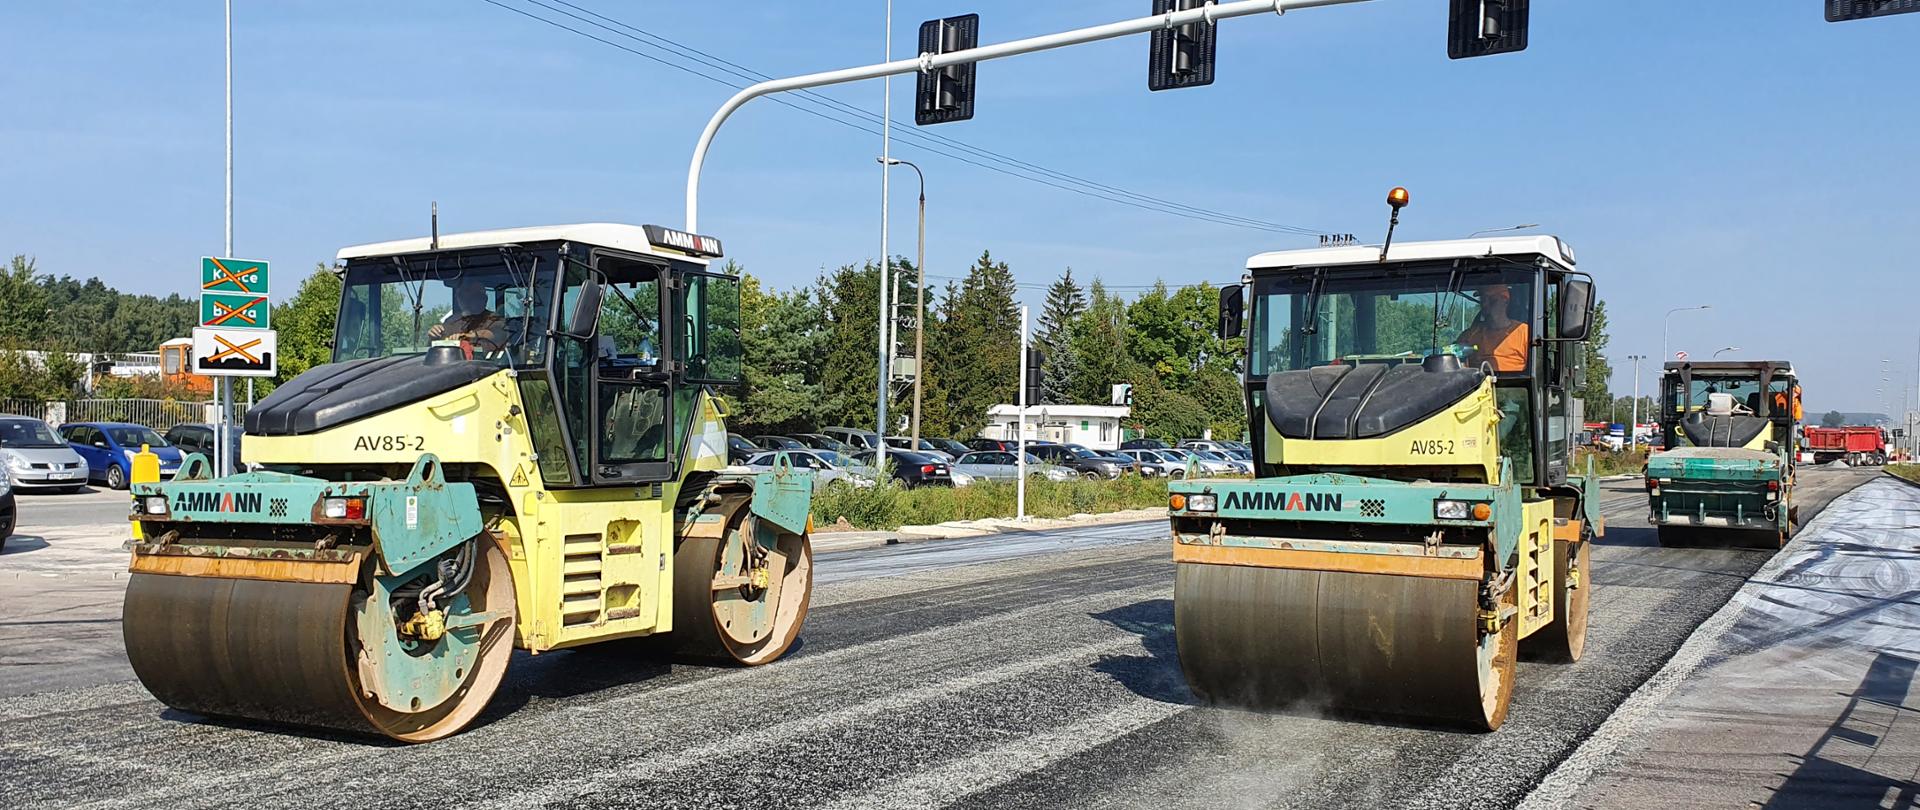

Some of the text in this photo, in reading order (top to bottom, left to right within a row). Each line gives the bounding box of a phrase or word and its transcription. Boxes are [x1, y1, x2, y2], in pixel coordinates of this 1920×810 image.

[663, 229, 719, 254] AMMANN
[354, 435, 425, 451] AV85-2
[1410, 440, 1454, 455] AV85-2
[174, 492, 262, 513] AMMANN
[1223, 491, 1342, 512] AMMANN
